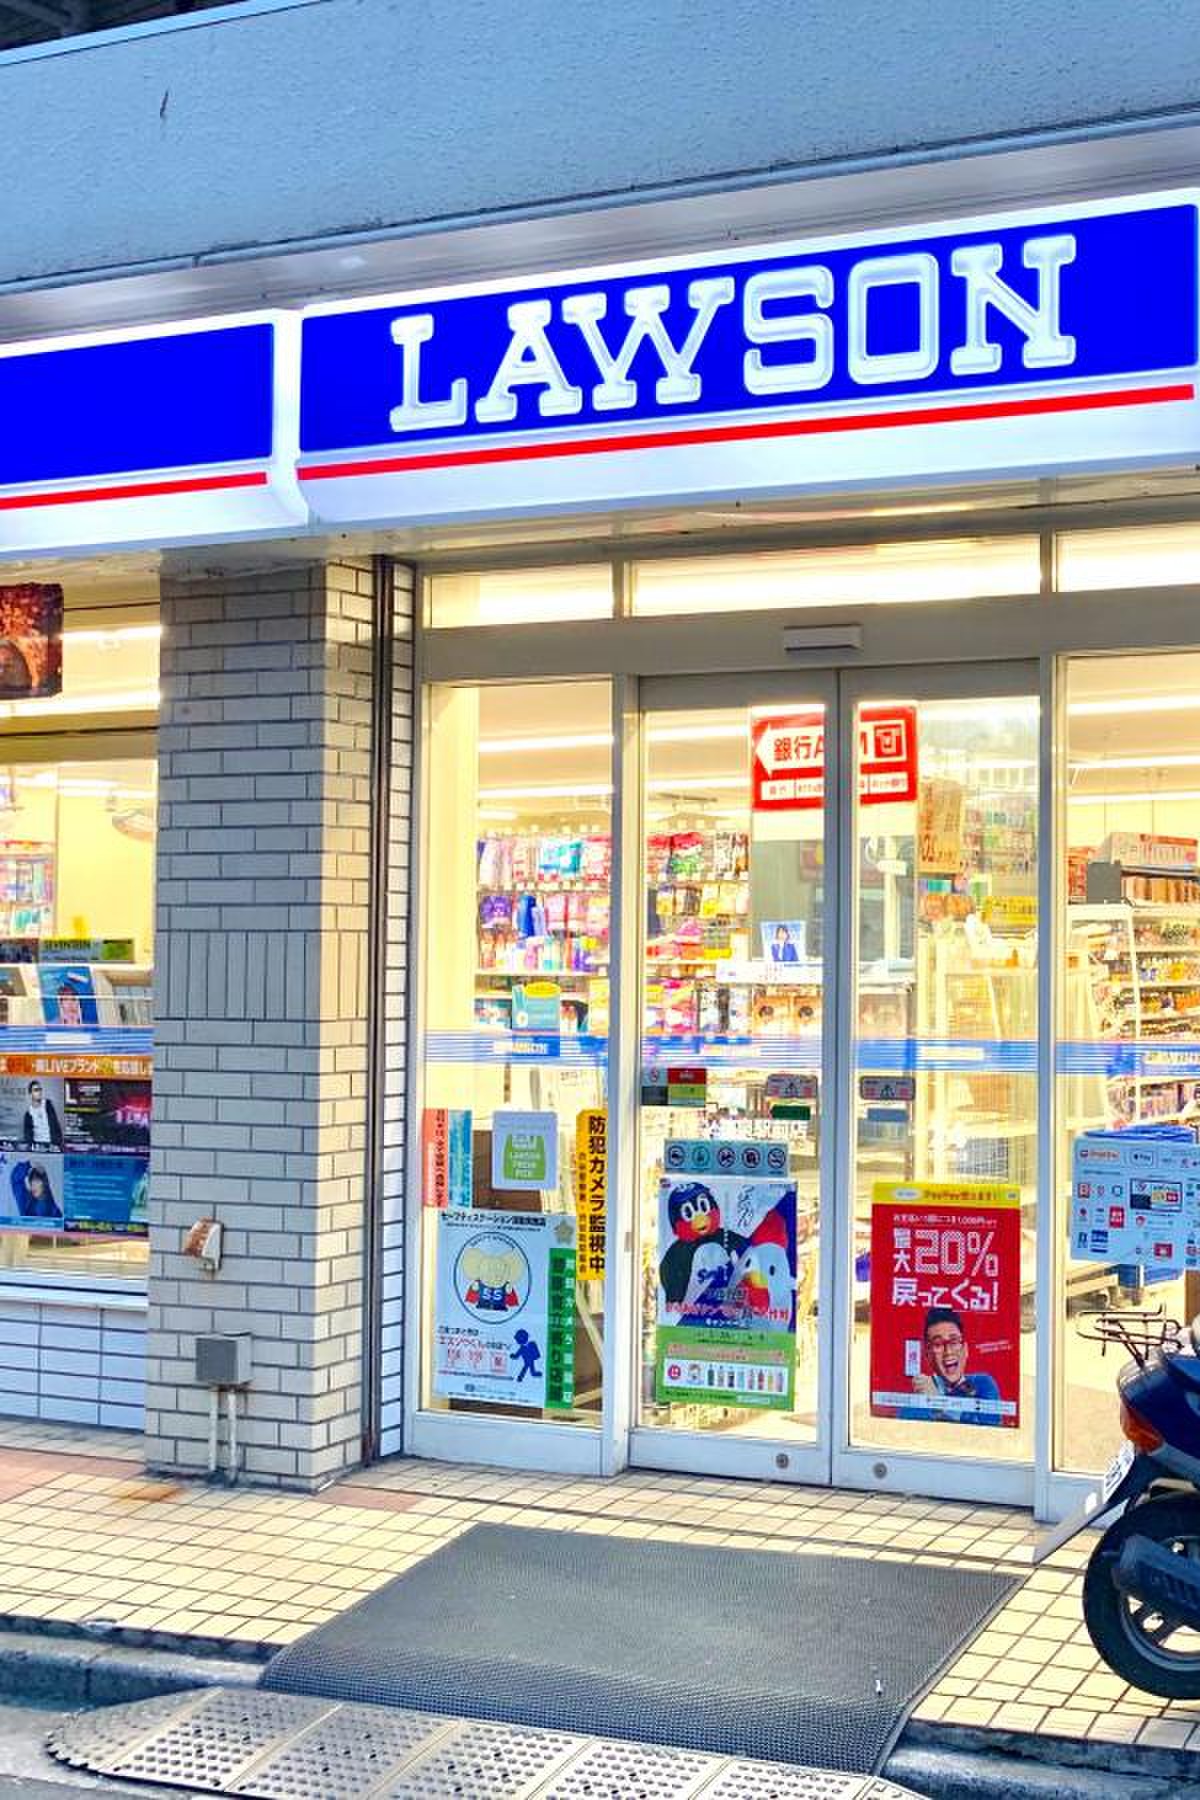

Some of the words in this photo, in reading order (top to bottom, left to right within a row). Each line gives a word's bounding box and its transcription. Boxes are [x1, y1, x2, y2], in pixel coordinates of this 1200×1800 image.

[388, 234, 1077, 433] LAWSON
[588, 1115, 607, 1275] 防犯カメラ監視中
[891, 1277, 999, 1312] 戻ってくる!
[892, 1227, 912, 1274] 最大
[914, 1229, 999, 1278] 20%
